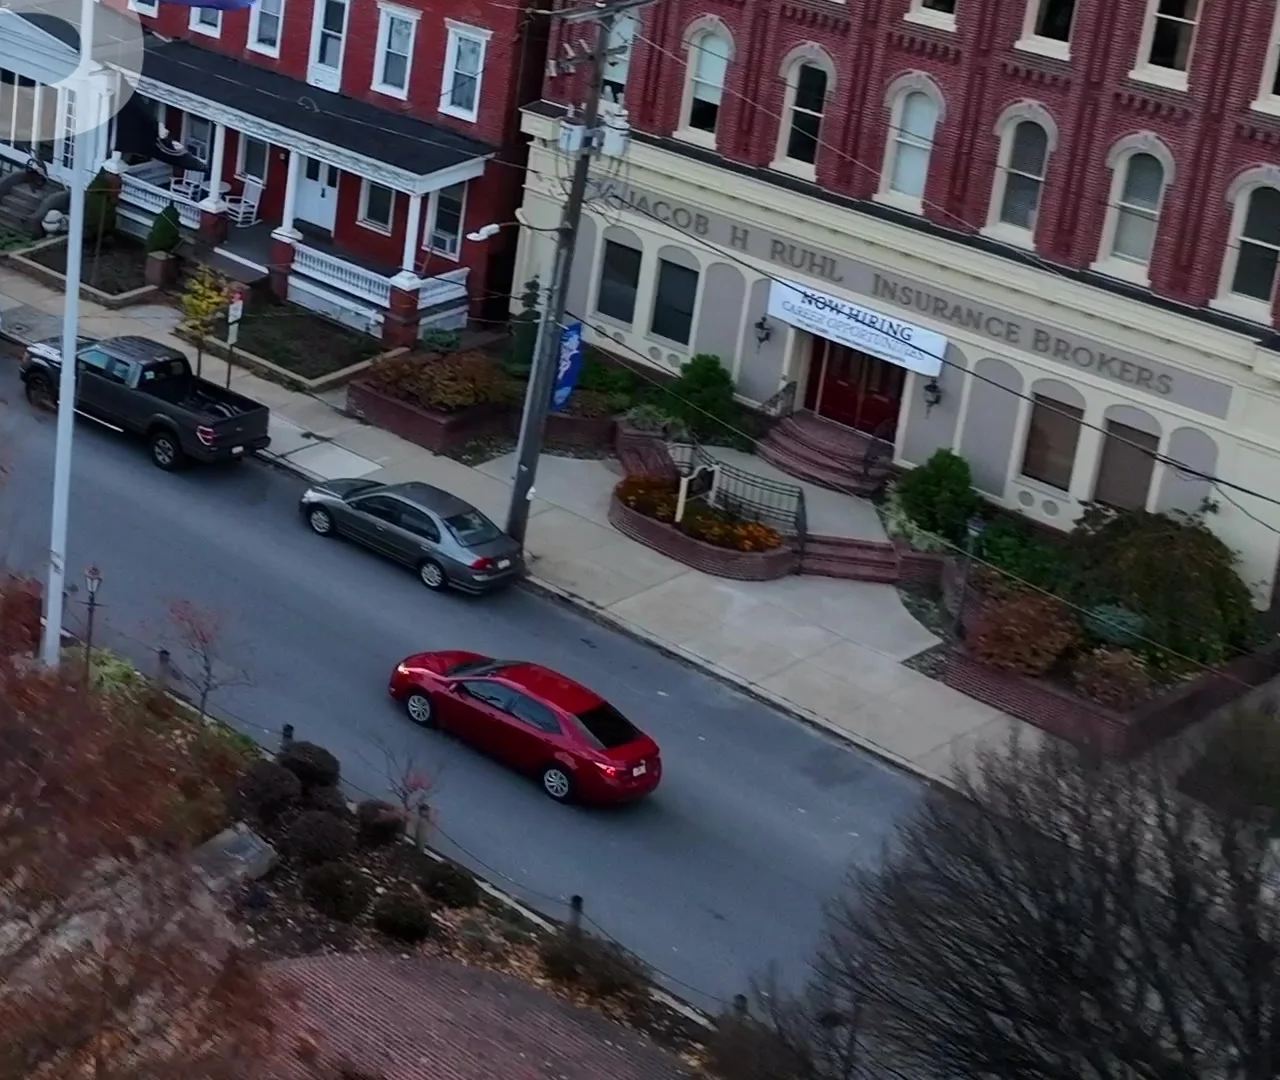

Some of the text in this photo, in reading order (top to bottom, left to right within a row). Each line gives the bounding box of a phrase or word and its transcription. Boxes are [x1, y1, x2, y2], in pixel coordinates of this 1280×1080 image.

[627, 191, 709, 235] JACOB
[728, 225, 749, 251] H
[770, 238, 844, 283] RUHL
[871, 272, 1022, 345] INSURANCE
[1030, 328, 1174, 395] BROKERS
[801, 291, 845, 315] NOW
[848, 308, 914, 342] HIRING
